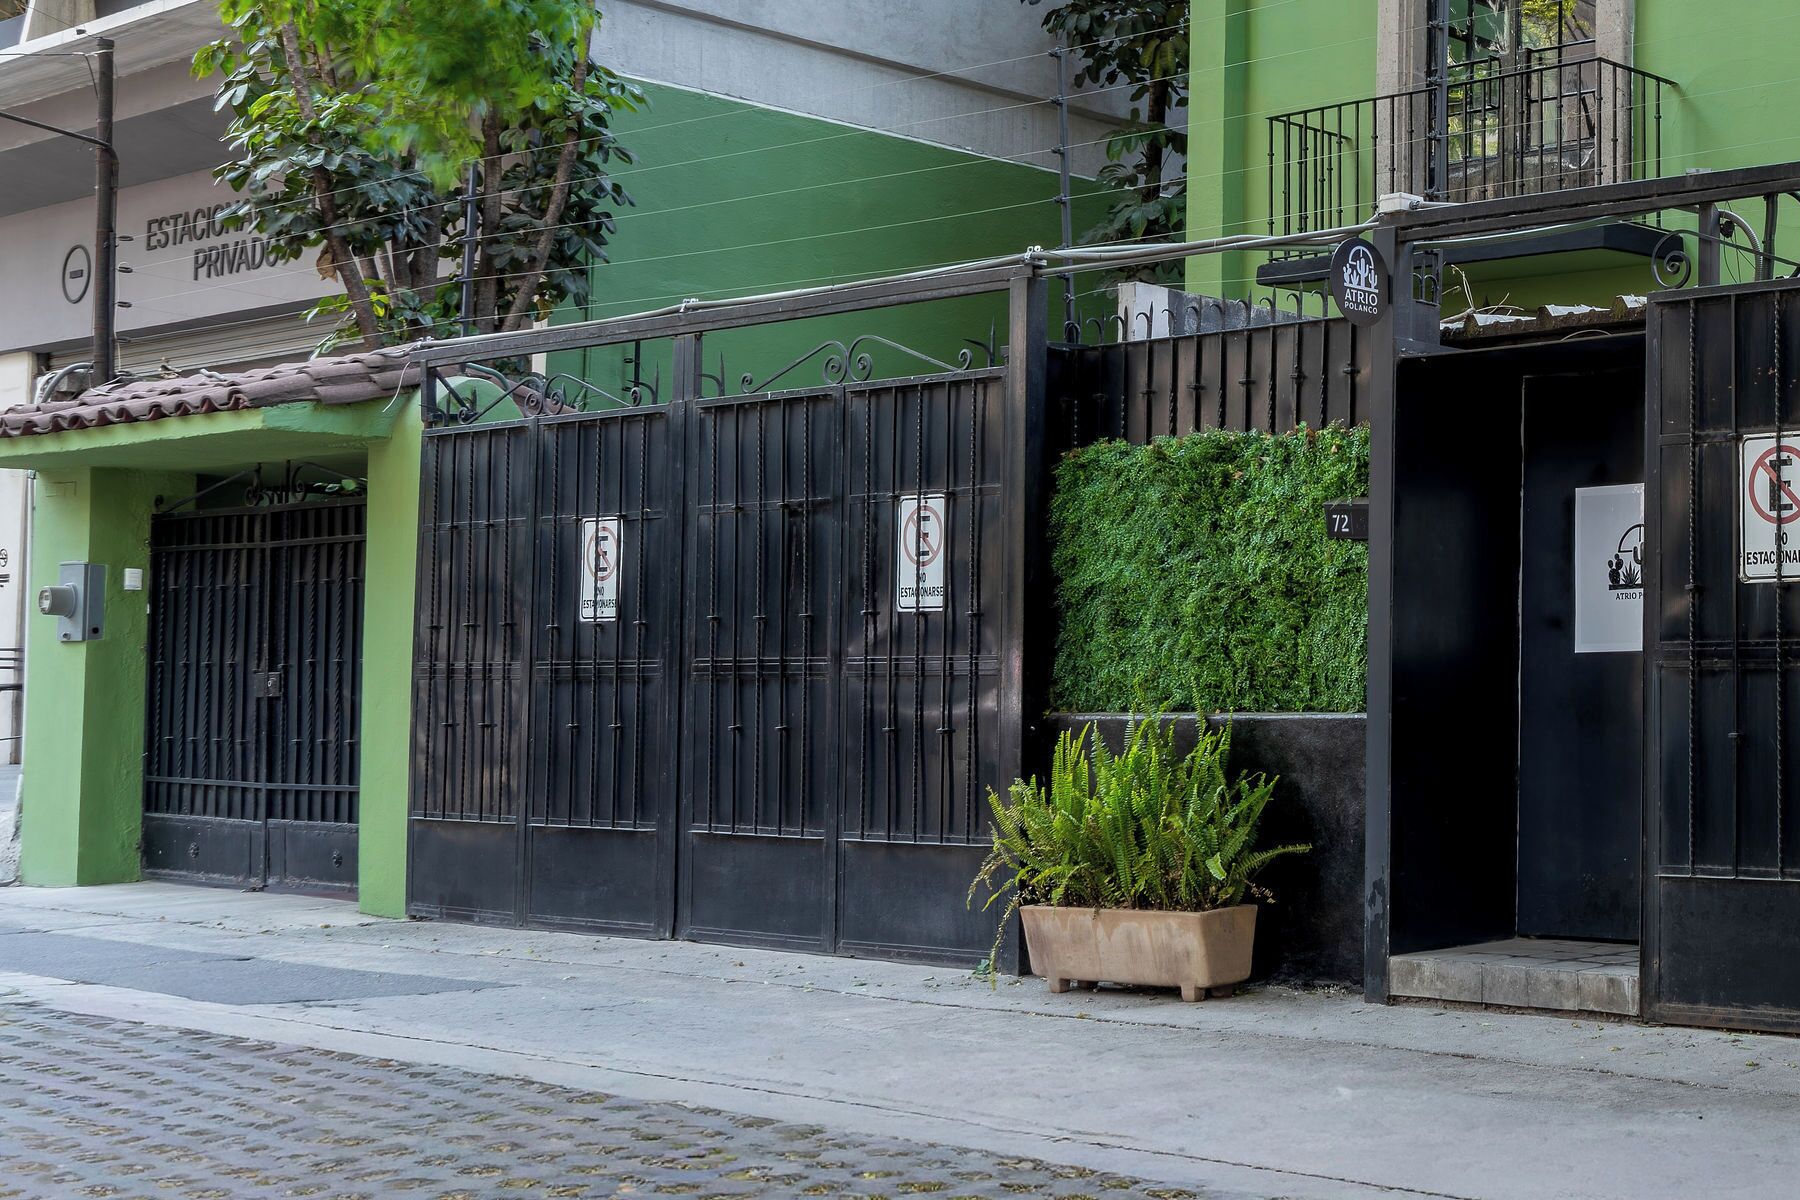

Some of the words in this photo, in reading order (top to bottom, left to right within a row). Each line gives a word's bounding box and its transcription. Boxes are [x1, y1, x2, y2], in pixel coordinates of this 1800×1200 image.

[193, 234, 279, 281] PRIVADO
[1344, 288, 1378, 306] ATRIO
[1344, 301, 1378, 315] POLANCO
[1332, 514, 1350, 532] 72
[900, 586, 944, 598] ESTAONARSE
[1615, 592, 1637, 600] ATRIO
